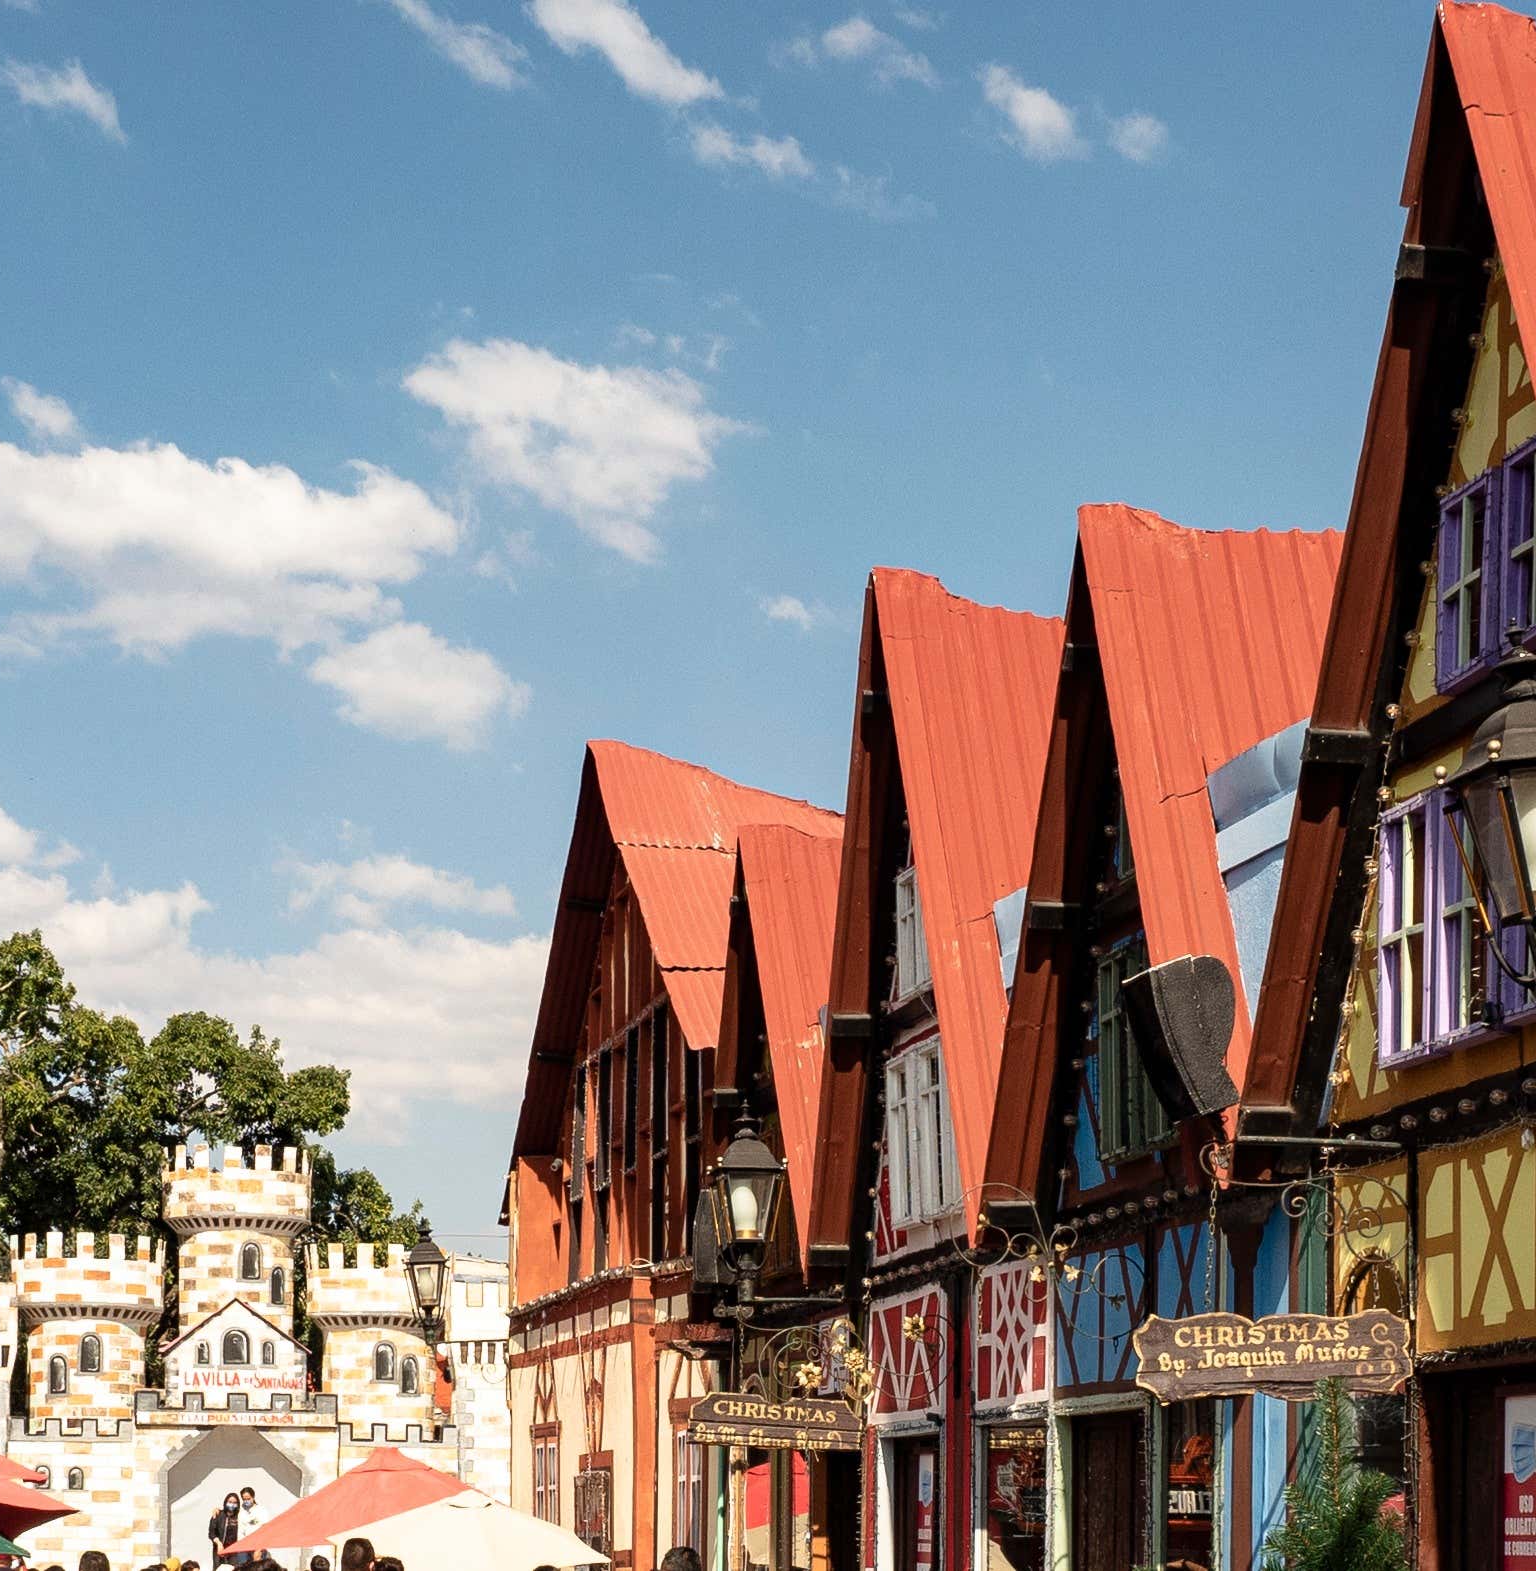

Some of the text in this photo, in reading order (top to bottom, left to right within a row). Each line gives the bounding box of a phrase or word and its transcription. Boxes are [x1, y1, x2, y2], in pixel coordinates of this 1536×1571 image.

[1174, 1320, 1349, 1348] CHRISTMAS
[1198, 1346, 1287, 1378] Joaquin
[1294, 1342, 1371, 1362] Muñoz
[184, 1372, 200, 1386] LA
[202, 1372, 240, 1386] VILLA
[713, 1400, 837, 1424] CHRISTMAS
[749, 1428, 791, 1448] Elena
[1519, 1495, 1534, 1514] USO
